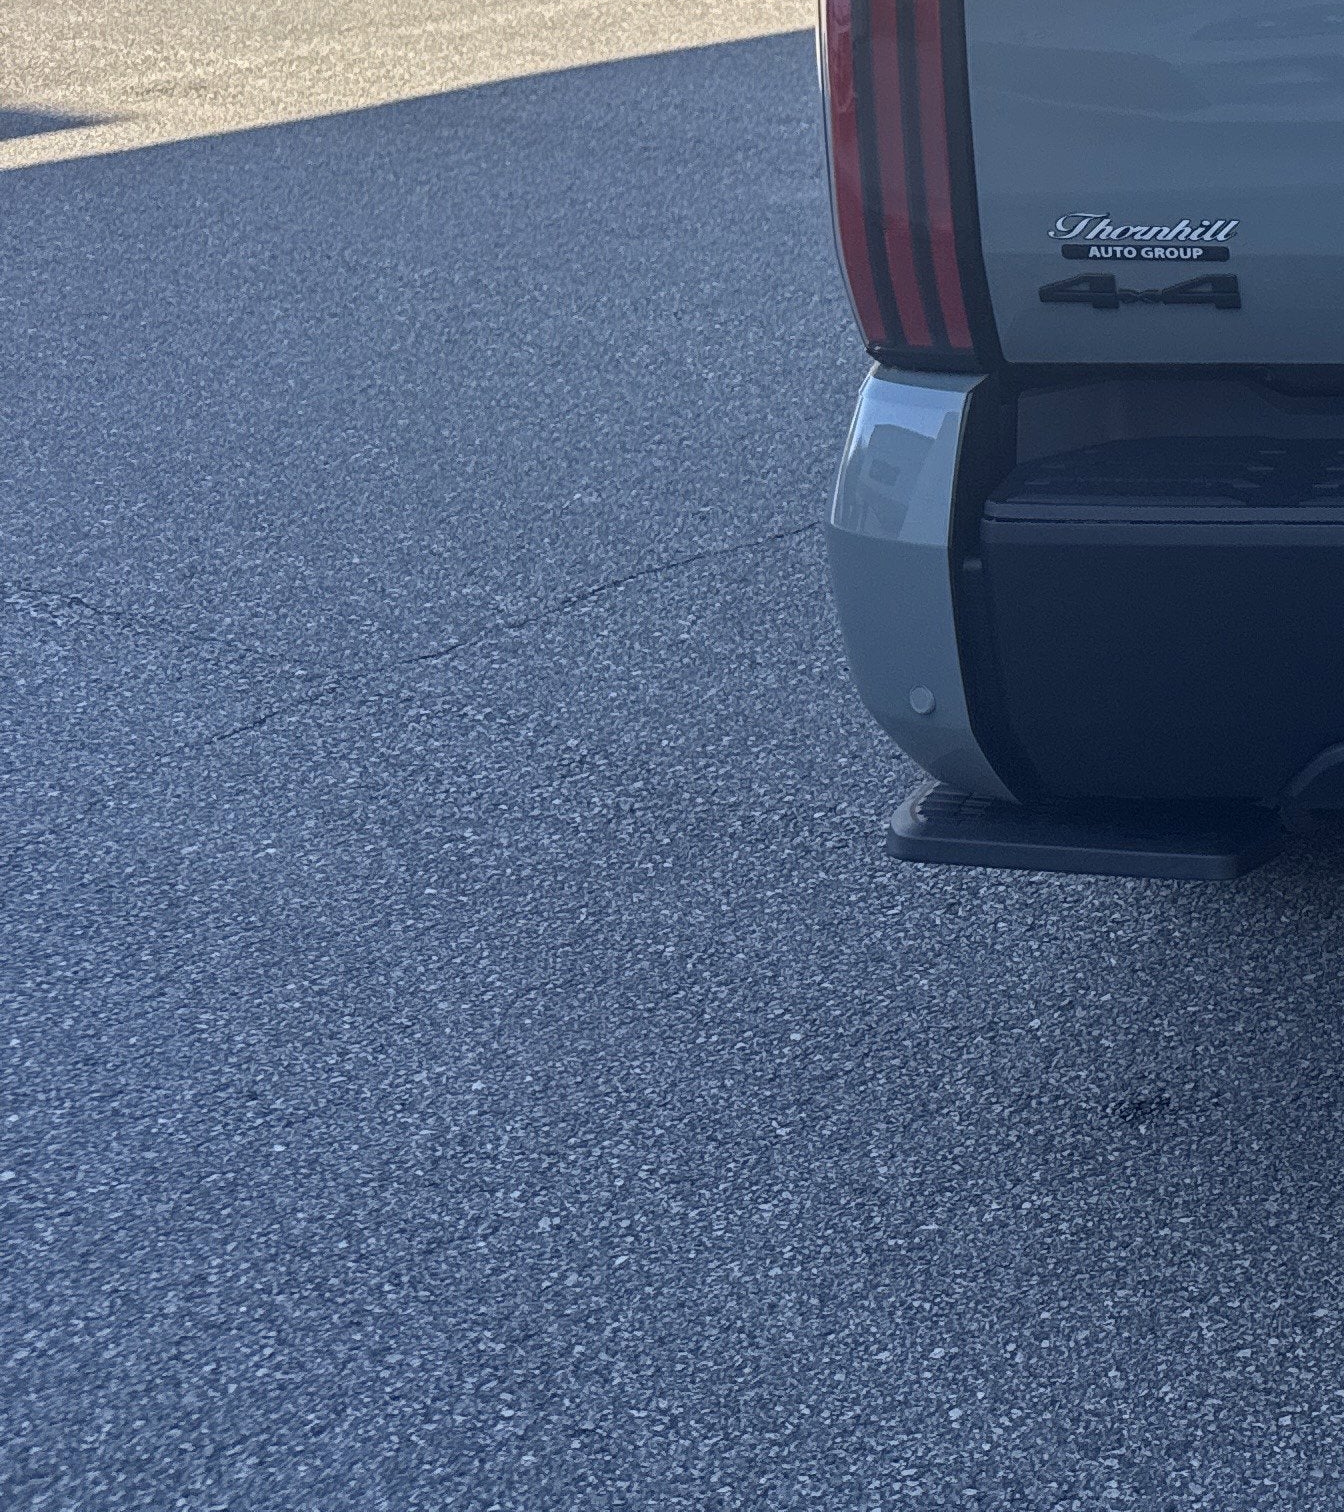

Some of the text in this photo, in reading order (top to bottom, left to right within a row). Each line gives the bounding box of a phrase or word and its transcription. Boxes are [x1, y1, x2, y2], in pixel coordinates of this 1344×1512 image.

[1047, 212, 1240, 243] Thornhill
[1088, 246, 1203, 259] AUTO GROUP
